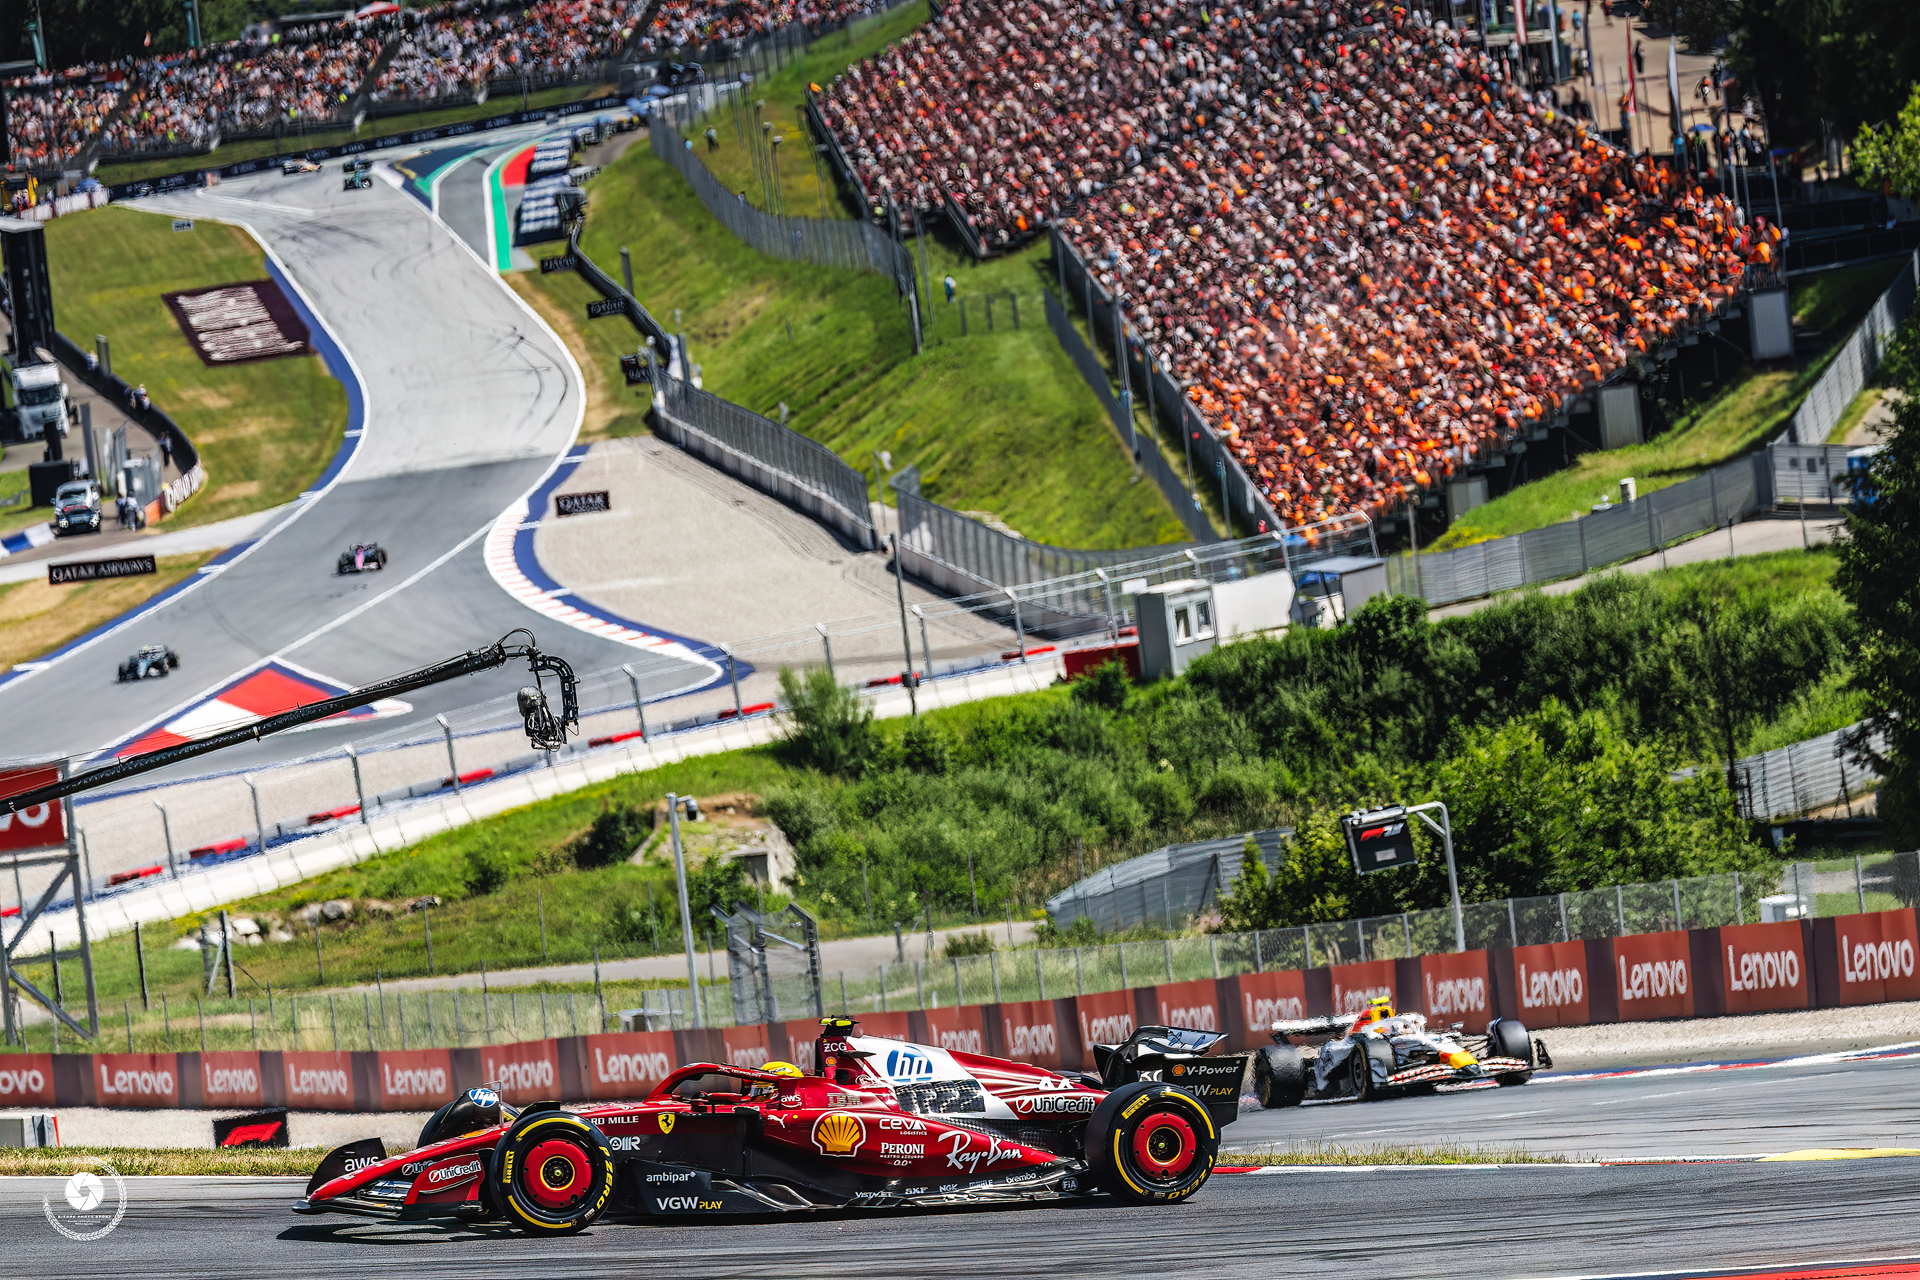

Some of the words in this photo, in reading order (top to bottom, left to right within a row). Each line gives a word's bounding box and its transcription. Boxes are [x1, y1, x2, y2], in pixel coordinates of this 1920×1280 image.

[1728, 944, 1800, 991] Lenovo
[1843, 935, 1915, 983] Lenovo
[1520, 964, 1584, 1008] Lenovo
[1619, 954, 1688, 1000] Lenovo
[1426, 971, 1487, 1016] Lenovo
[488, 1058, 554, 1091] Lenovo
[594, 1047, 669, 1083] Lenovo
[1186, 1065, 1239, 1076] V-Power
[0, 1069, 44, 1094] ovo
[100, 1064, 174, 1095] Lenovo
[205, 1062, 258, 1094] Lenovo
[289, 1063, 347, 1096] Lenovo
[384, 1063, 447, 1096] Lenovo
[781, 1095, 802, 1103] aws
[1210, 1087, 1234, 1096] PLAY
[1033, 1096, 1096, 1114] UniCredit
[608, 1115, 640, 1125] MILLE
[880, 1142, 925, 1155] PERONI
[440, 1161, 482, 1180] UniCredit
[646, 1172, 690, 1185] ambipar
[1005, 1172, 1037, 1184] brembo
[596, 1160, 614, 1210] ZERO
[904, 1186, 929, 1195] SKF
[939, 1183, 958, 1192] NGK
[656, 1196, 699, 1211] VGW
[699, 1200, 723, 1210] PLAY
